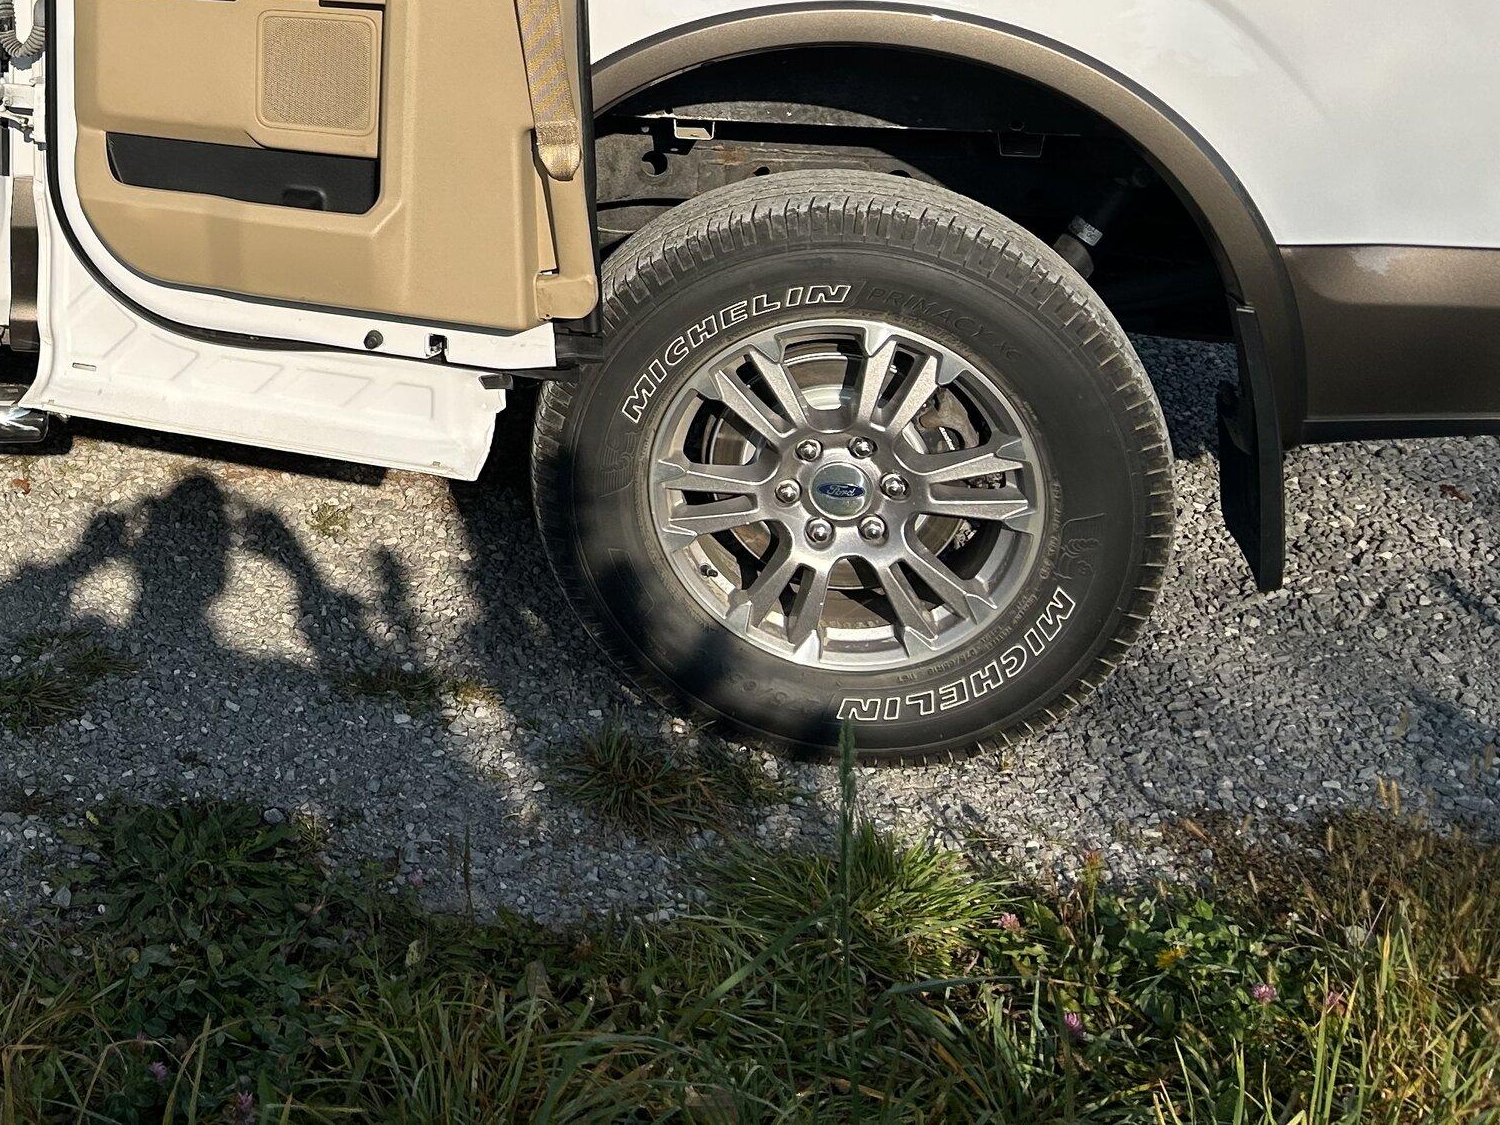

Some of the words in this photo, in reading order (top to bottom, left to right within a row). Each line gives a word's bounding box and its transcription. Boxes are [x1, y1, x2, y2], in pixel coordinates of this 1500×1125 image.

[621, 283, 851, 424] MICHELIN
[868, 287, 993, 338] PRIMACY
[826, 485, 856, 497] Ford
[837, 586, 1077, 722] MICHELIN
